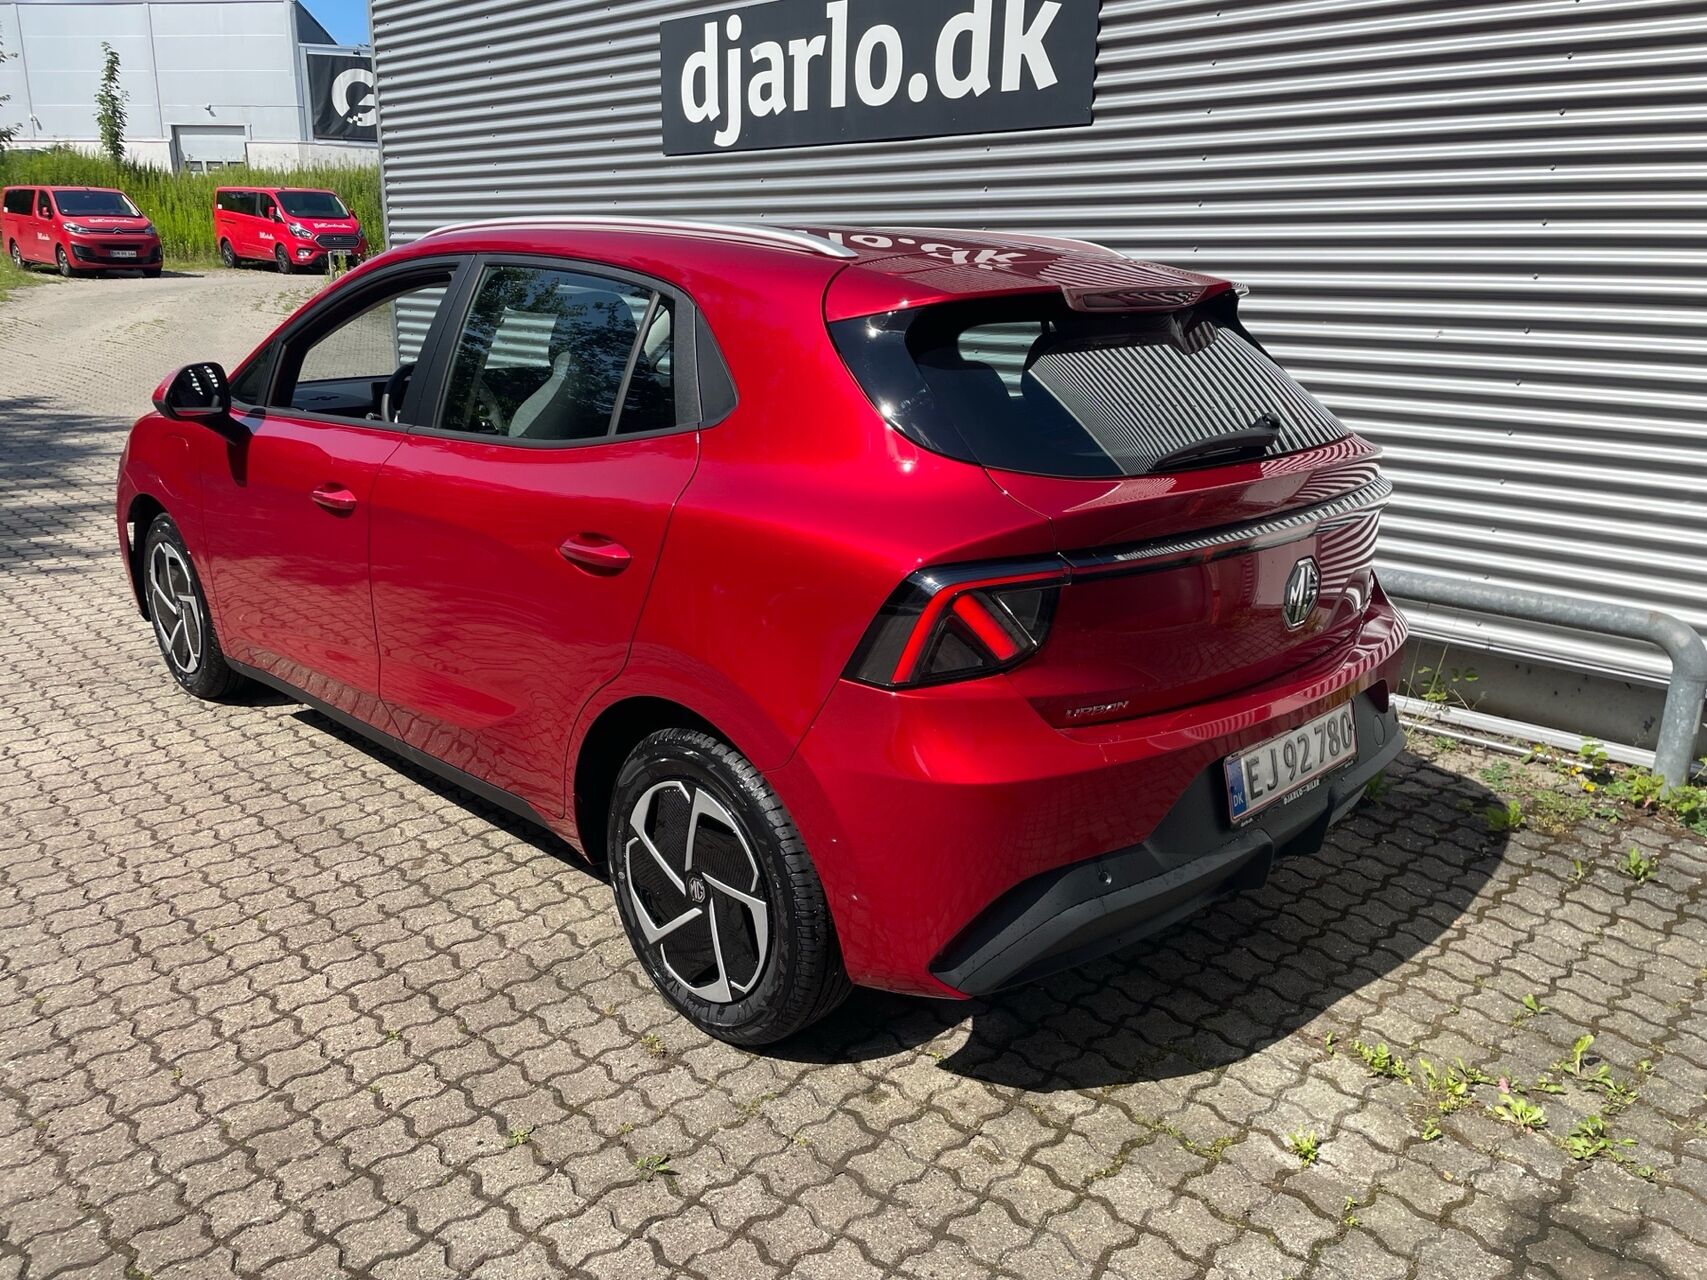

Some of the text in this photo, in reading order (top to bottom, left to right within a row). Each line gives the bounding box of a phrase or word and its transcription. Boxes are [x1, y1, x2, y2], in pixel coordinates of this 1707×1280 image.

[680, 0, 1063, 147] djarlo.dk
[1287, 560, 1318, 626] MG
[1246, 711, 1353, 801] EJ 92 780
[1233, 794, 1245, 808] DK
[690, 879, 706, 901] MG
